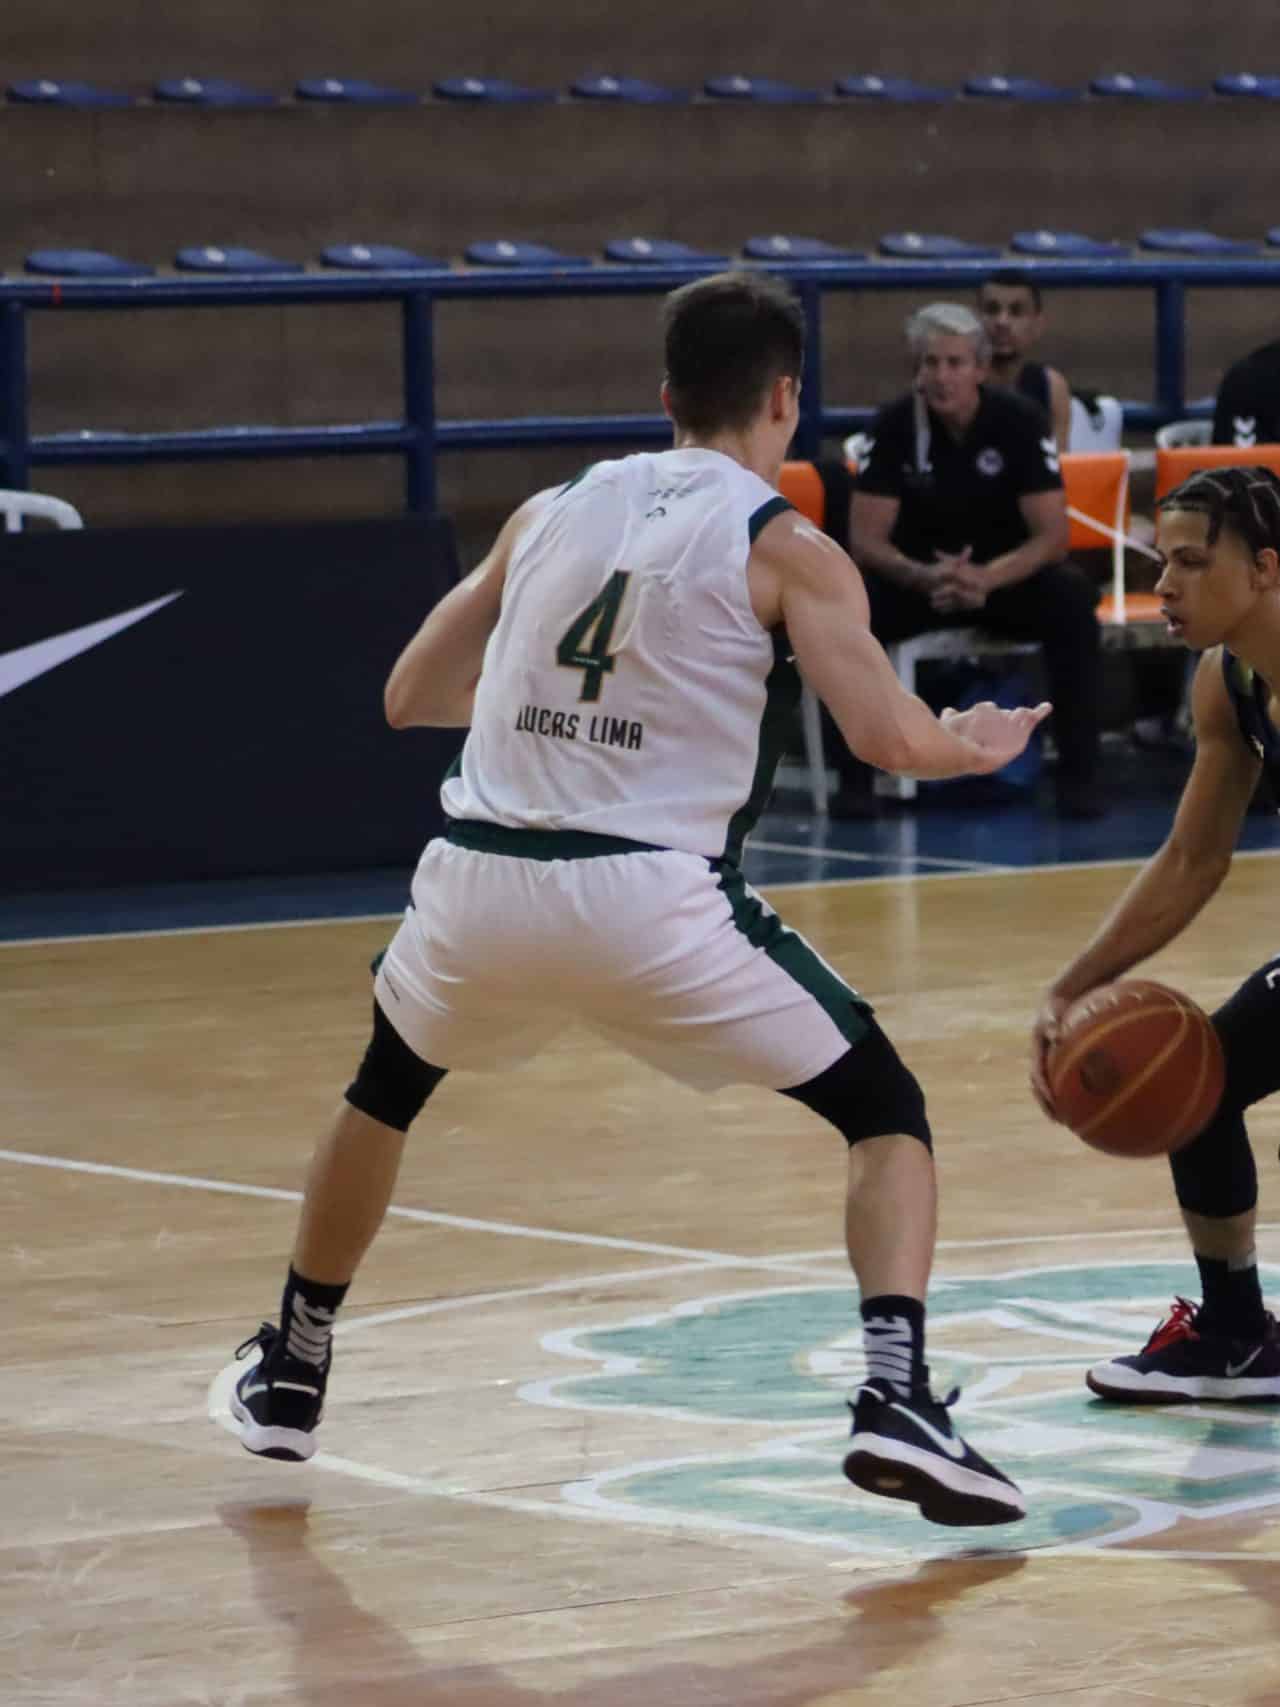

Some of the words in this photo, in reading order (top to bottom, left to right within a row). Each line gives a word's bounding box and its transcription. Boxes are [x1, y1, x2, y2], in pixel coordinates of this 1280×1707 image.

[555, 569, 630, 703] 4
[515, 705, 580, 740] LUCAS
[589, 715, 644, 751] LIMA
